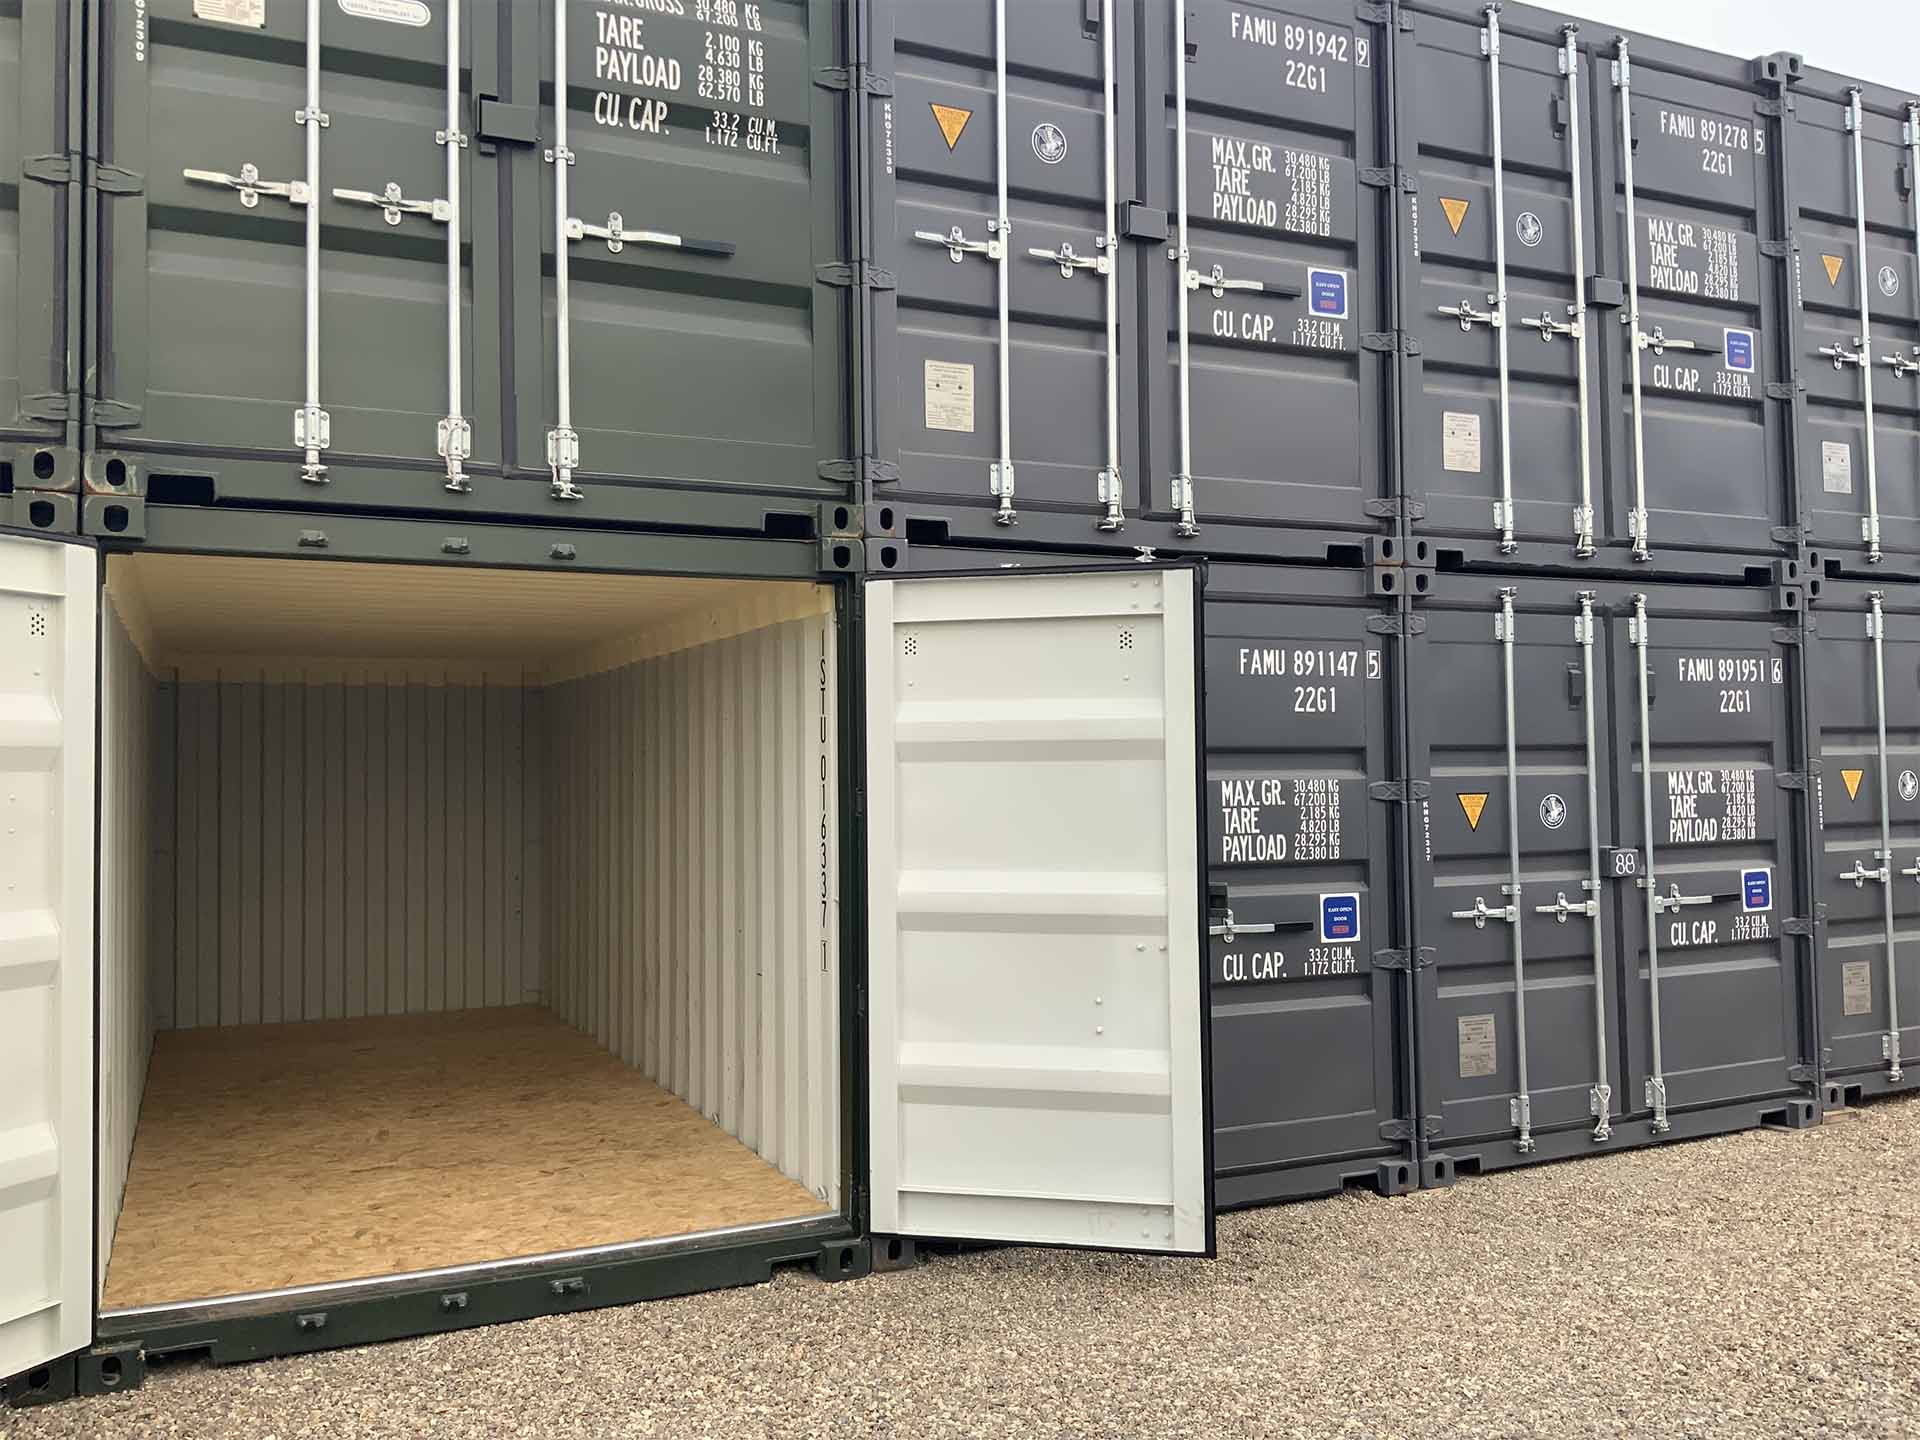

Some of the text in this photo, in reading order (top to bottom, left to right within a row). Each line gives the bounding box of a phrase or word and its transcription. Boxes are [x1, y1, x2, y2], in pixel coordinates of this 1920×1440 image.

[696, 10, 762, 32] 67.200 LB
[745, 3, 760, 20] KG
[596, 12, 644, 50] TARE
[1231, 12, 1368, 66] FAMU 891942 9
[705, 32, 764, 57] 2.100 KG
[596, 47, 680, 91] PAYLOAD
[705, 50, 764, 73] 4.630 LB
[698, 65, 764, 91] 28.380 KG
[1285, 60, 1326, 93] 22G1
[698, 83, 764, 107] 62.570 LB
[594, 92, 670, 135] CU. CAP.
[712, 111, 778, 138] 33.2 CU.M.
[705, 127, 781, 154] 1.172 CU.FT.
[1660, 111, 1764, 153] FAMU 891278 5
[1284, 150, 1330, 170] 30.480 KG
[1703, 149, 1732, 176] 22G1
[1213, 165, 1250, 196] TARE
[1285, 164, 1330, 184] 67.200 LB
[1291, 179, 1330, 197] 2.185 KG
[1213, 192, 1277, 227] PAYLOAD
[1291, 193, 1330, 210] 4.820 LB
[1285, 204, 1330, 223] 28.295 KG
[1285, 219, 1330, 237] 62.380 LB
[1650, 241, 1678, 268] TARE
[1729, 243, 1737, 255] LB
[1650, 265, 1698, 293] PAYLOAD
[1729, 266, 1738, 277] LB
[1730, 289, 1738, 301] LB
[1213, 310, 1276, 343] CU. CAP.
[1297, 318, 1343, 336] 33.2 CU.M.
[1293, 331, 1346, 351] 1.172 CU.FT.
[1654, 364, 1701, 393] CU. CAP.
[1716, 371, 1731, 384] 33.2
[1240, 648, 1379, 677] FAMU 891147 5
[1679, 658, 1781, 682] FAMU 891951 6
[1294, 686, 1336, 712] 22G1
[1720, 689, 1750, 712] 22G1
[1294, 779, 1339, 793] 30.480 KG
[1720, 770, 1754, 781] 30.480 KG
[1721, 781, 1754, 793] 67.200 LB
[1294, 793, 1339, 806] 67.200 LB
[1669, 795, 1698, 818] TARE
[1747, 793, 1755, 804] KG
[1222, 807, 1260, 834] TARE
[1300, 806, 1340, 820] 2.185 KG
[1747, 805, 1755, 816] LB
[1300, 820, 1340, 833] 4.820 LB
[1670, 818, 1717, 842] PAYLOAD
[1747, 816, 1756, 828] KG
[819, 754, 829, 928] 016337
[1294, 833, 1340, 846] 28.295 KG
[1722, 828, 1756, 840] 62.380 LB
[1223, 834, 1286, 862] PAYLOAD
[1294, 847, 1340, 860] 62.380 LB
[1615, 853, 1635, 874] 88
[1671, 920, 1718, 945] CU. CAP.
[1735, 916, 1750, 928] 33.2
[1731, 928, 1750, 941] 1.172
[1309, 946, 1354, 962] 33.2 CU.M.
[1223, 951, 1287, 981] CU. CAP.
[1304, 959, 1358, 975] 1.172 CU.FT.
